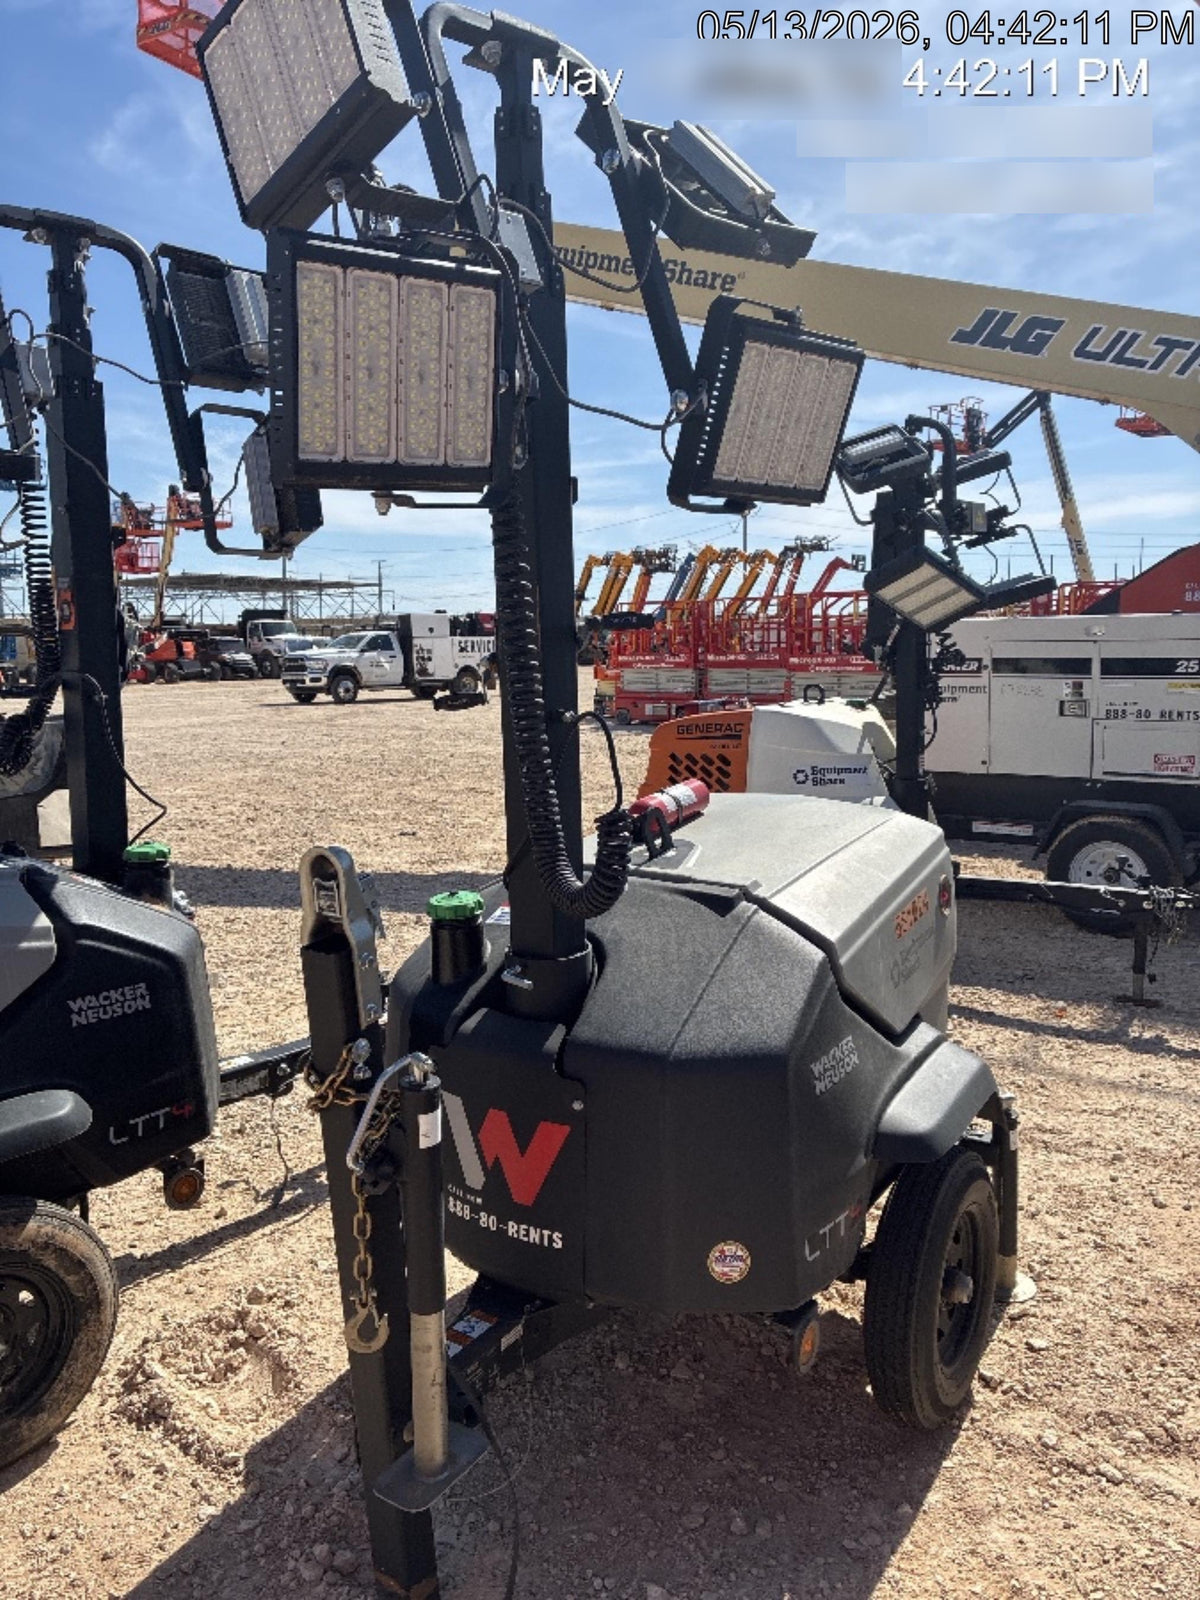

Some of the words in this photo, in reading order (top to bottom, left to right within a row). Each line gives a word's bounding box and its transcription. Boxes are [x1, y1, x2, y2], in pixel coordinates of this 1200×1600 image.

[949, 307, 1069, 358] JLG
[457, 638, 497, 654] SERVIC
[1174, 660, 1200, 673] 25
[1105, 708, 1152, 719] 888-80
[1160, 709, 1200, 721] RENTS
[676, 722, 745, 735] GENERAC
[810, 765, 868, 777] Equipment
[811, 777, 846, 787] Share
[67, 982, 150, 1013] WACKER
[70, 995, 152, 1028] NEUSON
[810, 1035, 856, 1078] WACKER
[814, 1050, 860, 1096] NEUSON
[109, 1099, 193, 1146] LTT4
